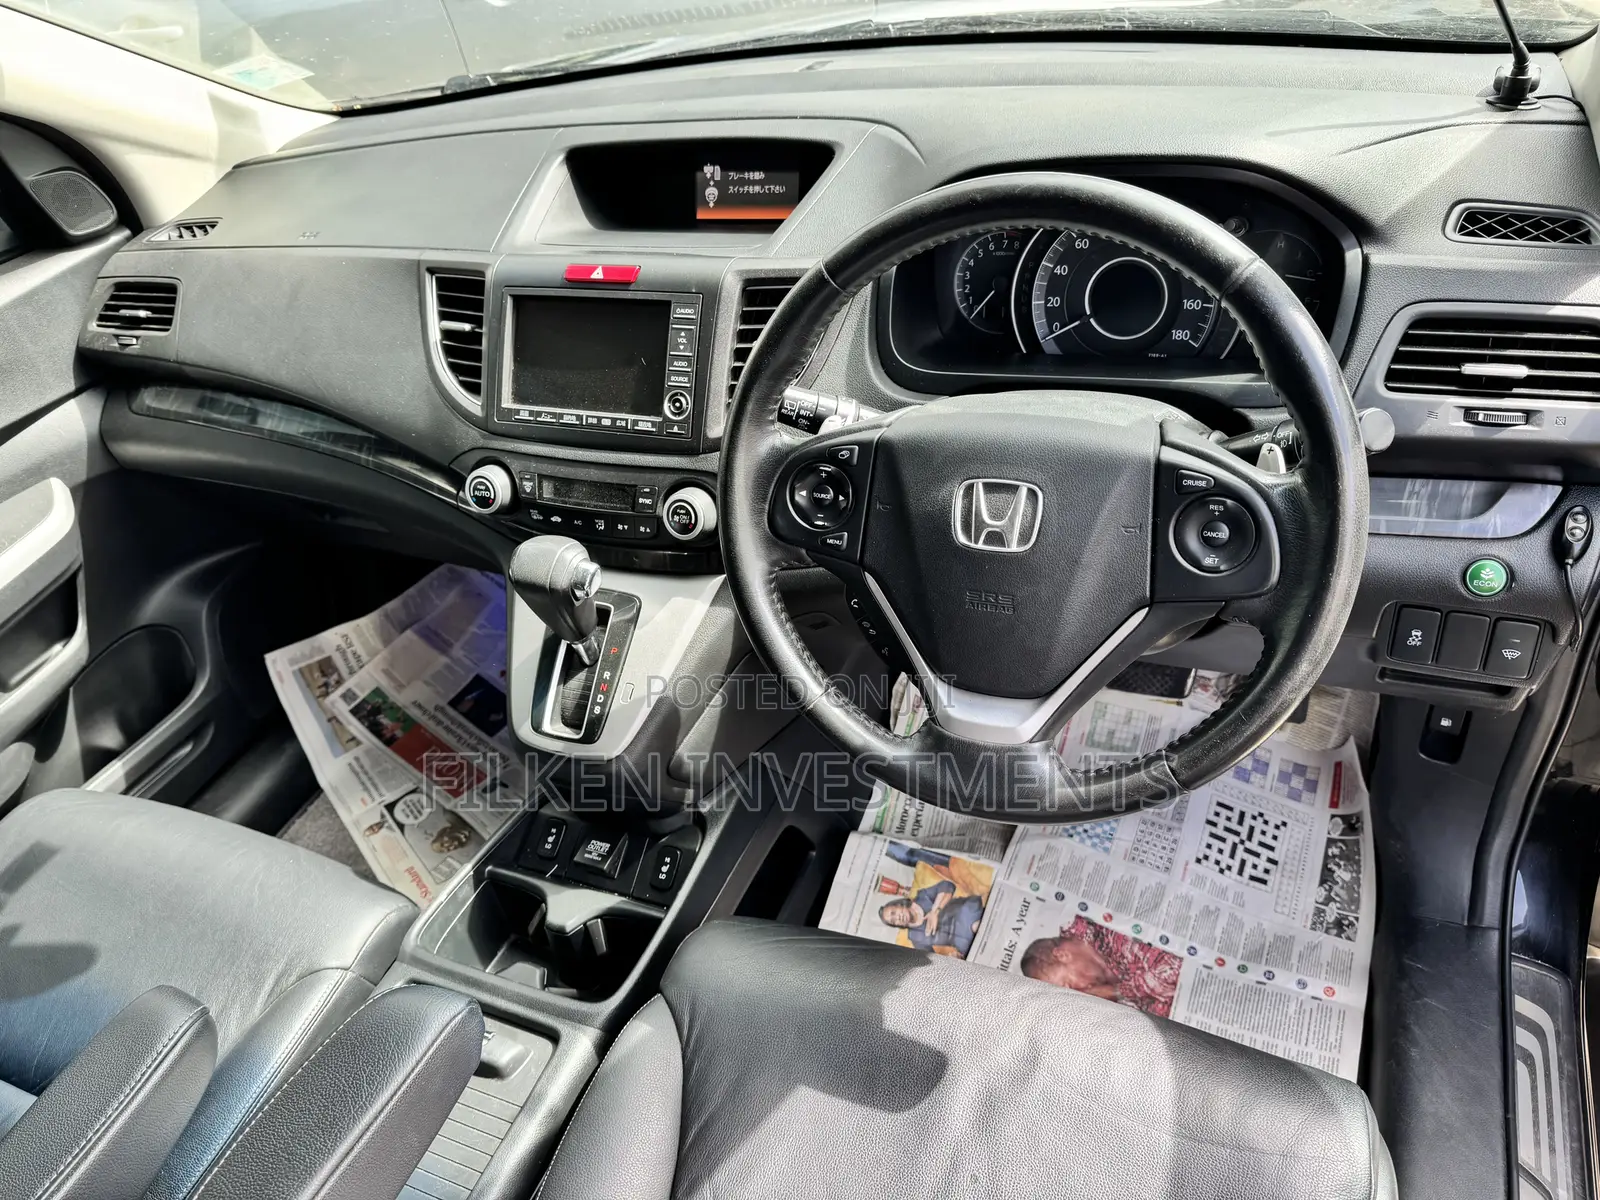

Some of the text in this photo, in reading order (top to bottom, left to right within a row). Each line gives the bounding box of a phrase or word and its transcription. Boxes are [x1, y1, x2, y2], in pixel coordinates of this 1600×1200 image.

[728, 185, 786, 194] スイッチを押して下さい
[1075, 238, 1089, 250] 60
[1054, 264, 1068, 276] 40
[1046, 297, 1060, 308] 20
[1182, 299, 1202, 310] 160
[1052, 322, 1060, 332] 0
[1171, 329, 1190, 340] 180
[813, 492, 832, 500] SOURCE
[1203, 530, 1226, 539] CANCEL
[1473, 580, 1498, 588] ECON
[966, 592, 1014, 604] SRS
[966, 602, 1014, 615] AIRBAG
[604, 672, 610, 680] R
[600, 683, 608, 692] N
[597, 694, 604, 702] D
[594, 706, 600, 714] S
[590, 840, 610, 848] POWER
[1016, 897, 1031, 926] year
[1012, 927, 1022, 936] A
